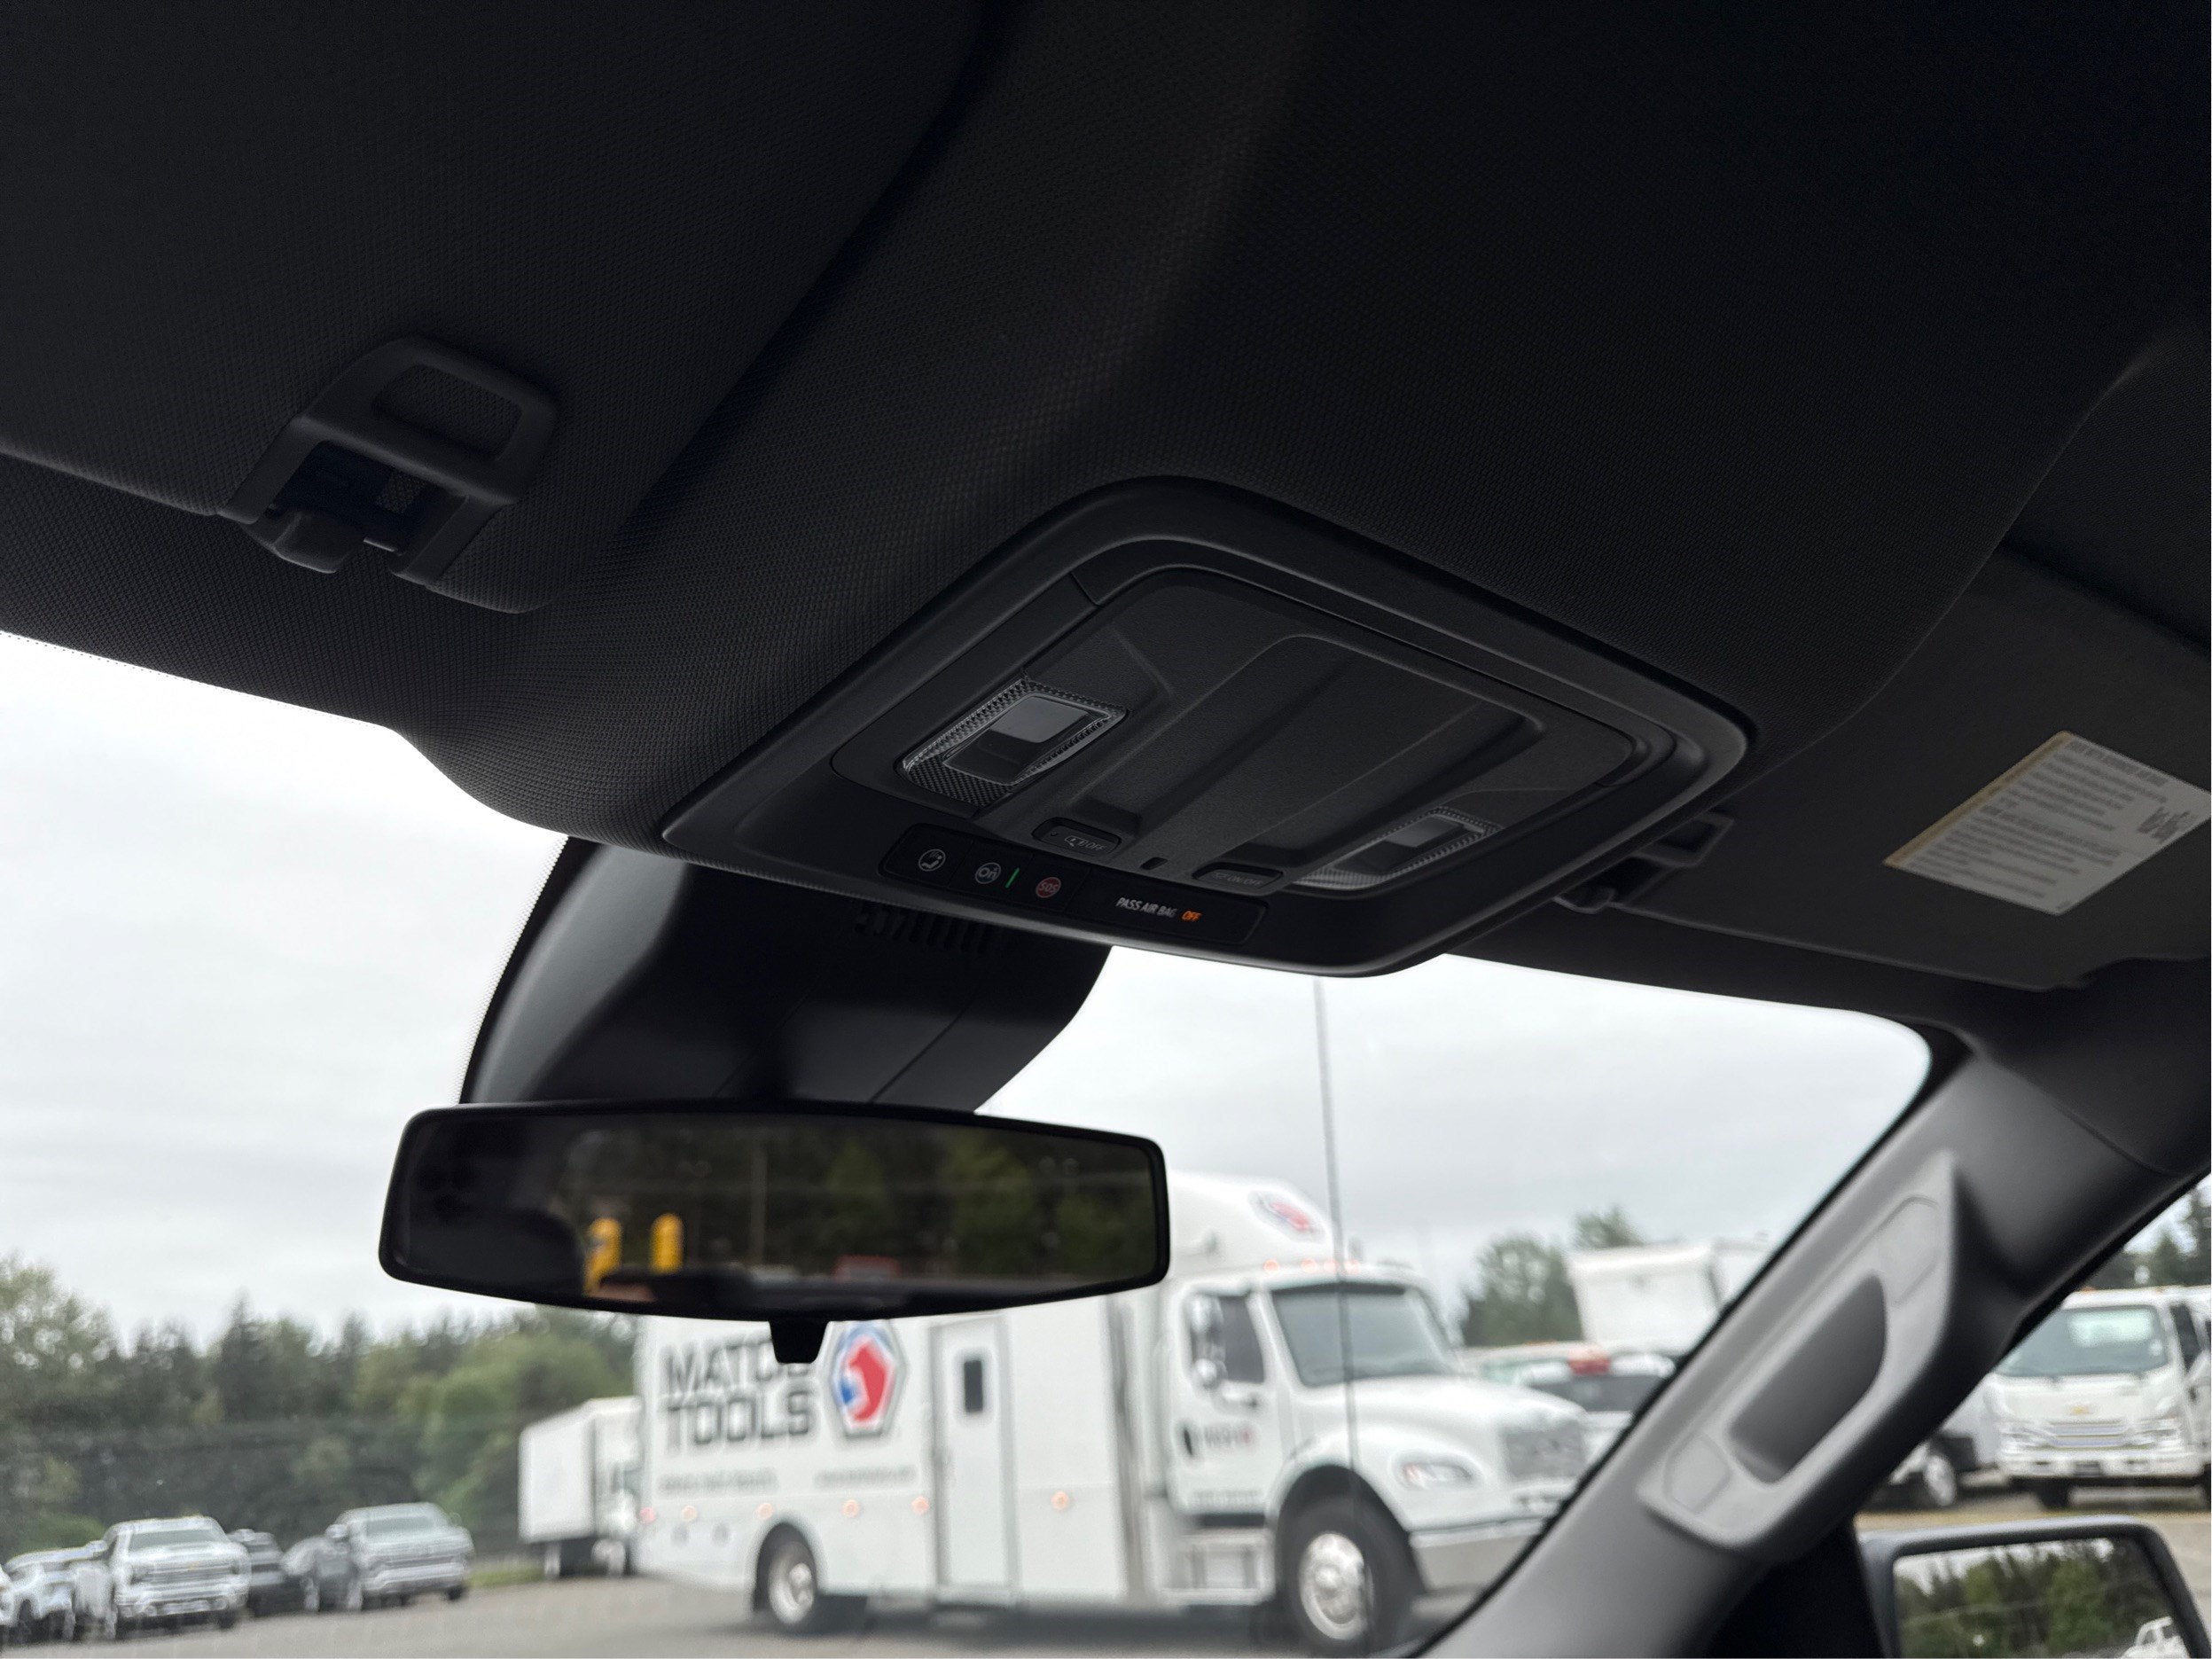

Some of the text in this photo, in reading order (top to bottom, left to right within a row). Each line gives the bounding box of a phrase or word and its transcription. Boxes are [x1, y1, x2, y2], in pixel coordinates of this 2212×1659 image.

[1038, 881, 1059, 893] SOS
[1115, 897, 1203, 922] PASS AIR BAG OFF
[664, 1388, 811, 1451] TOOLS
